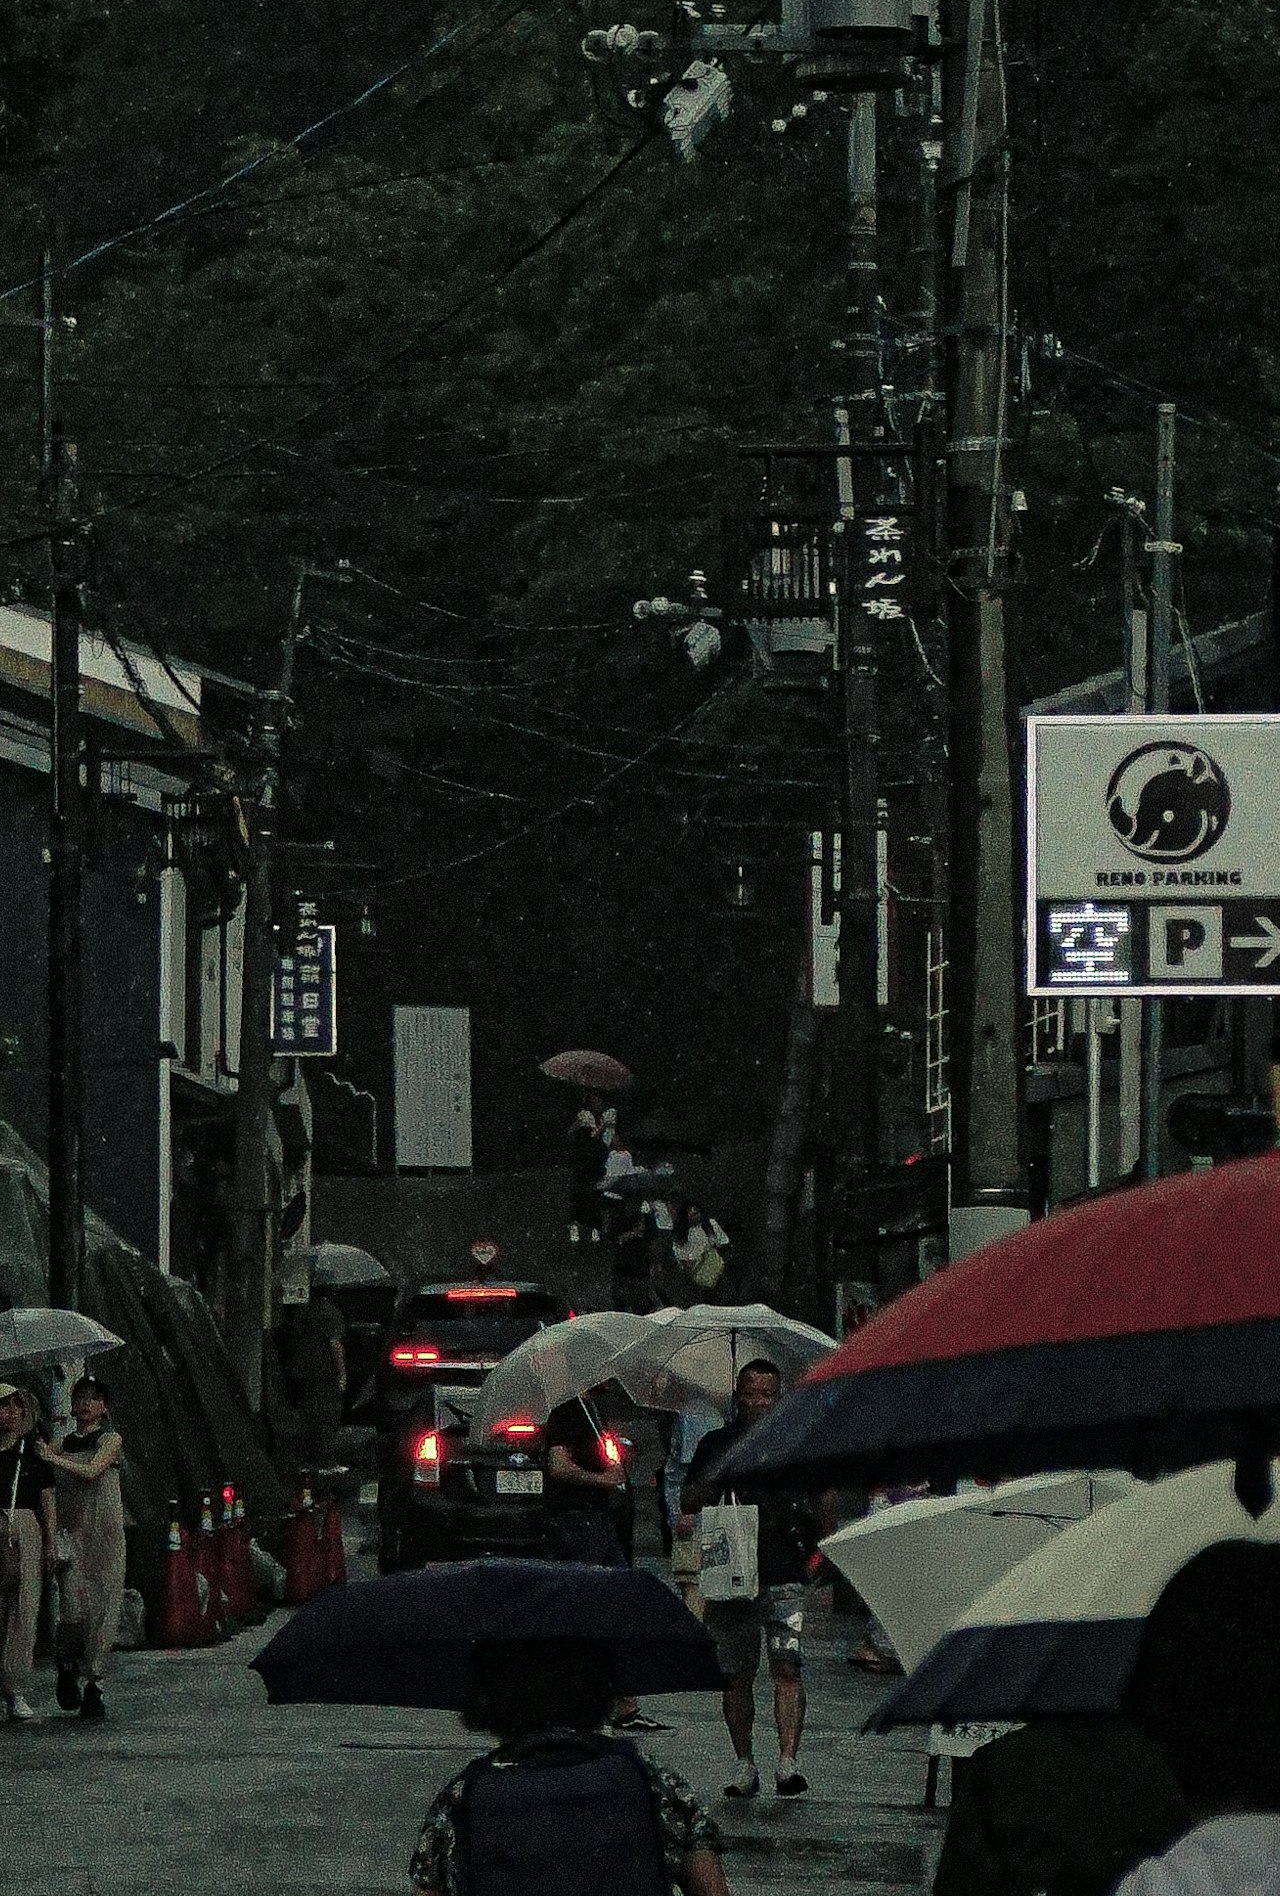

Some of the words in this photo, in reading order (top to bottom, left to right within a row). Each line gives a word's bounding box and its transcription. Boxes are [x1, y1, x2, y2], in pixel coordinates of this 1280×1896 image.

[861, 516, 906, 620] 茶わん坂
[1095, 871, 1146, 887] RENO
[1152, 871, 1242, 887] PARKING
[1049, 903, 1129, 982] 空
[1166, 918, 1206, 966] P
